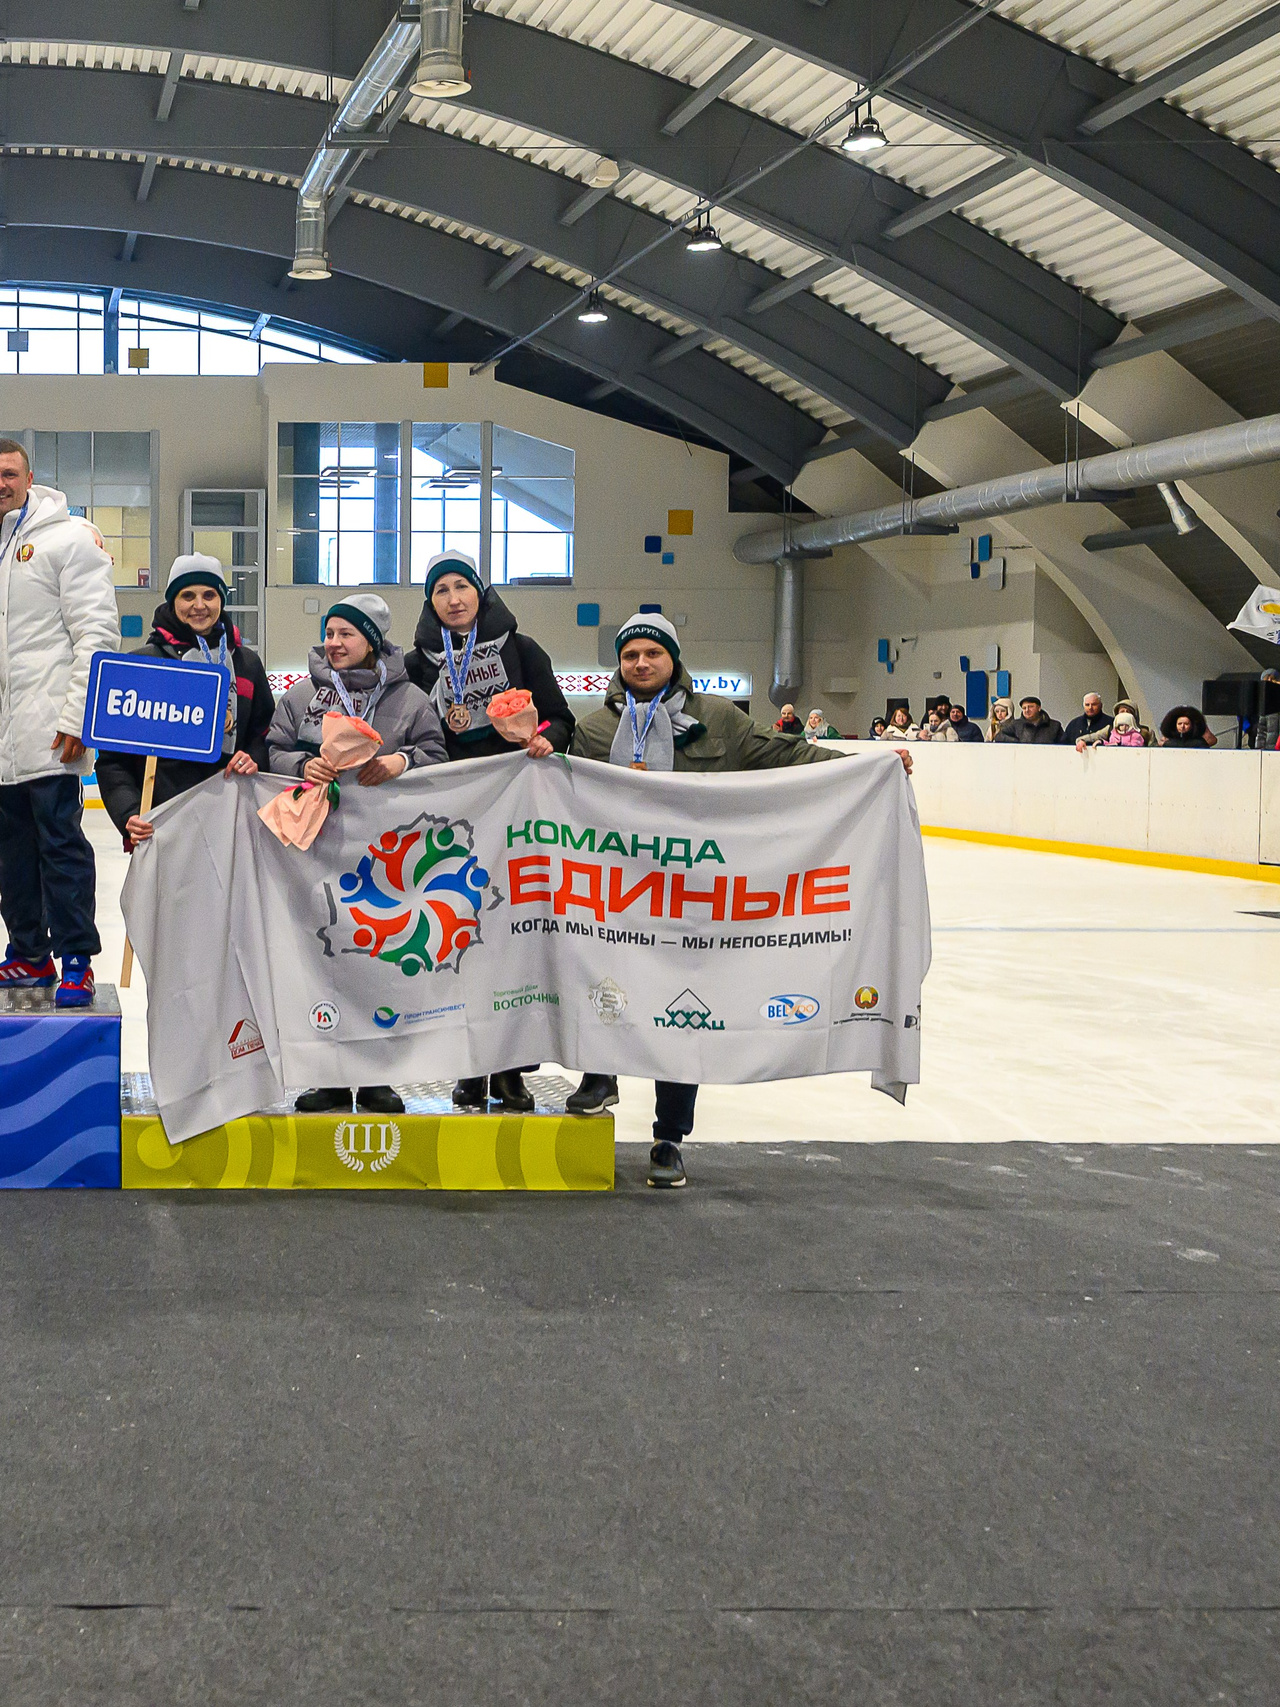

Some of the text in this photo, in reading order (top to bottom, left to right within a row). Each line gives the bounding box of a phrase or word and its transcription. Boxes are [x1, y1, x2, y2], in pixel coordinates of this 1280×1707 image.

[445, 663, 501, 690] ЕИНЫЕ
[106, 688, 205, 726] Единые
[506, 819, 726, 868] КОМАНДА
[507, 854, 851, 923] ЕДИНЫЕ
[510, 918, 560, 935] КОГДА
[565, 920, 594, 937] МЫ
[597, 927, 656, 946] ЕДИНЫ
[682, 936, 715, 949] МЫ
[719, 928, 852, 949] НЕПОБЕДИМЫ!
[345, 1123, 391, 1153] III
